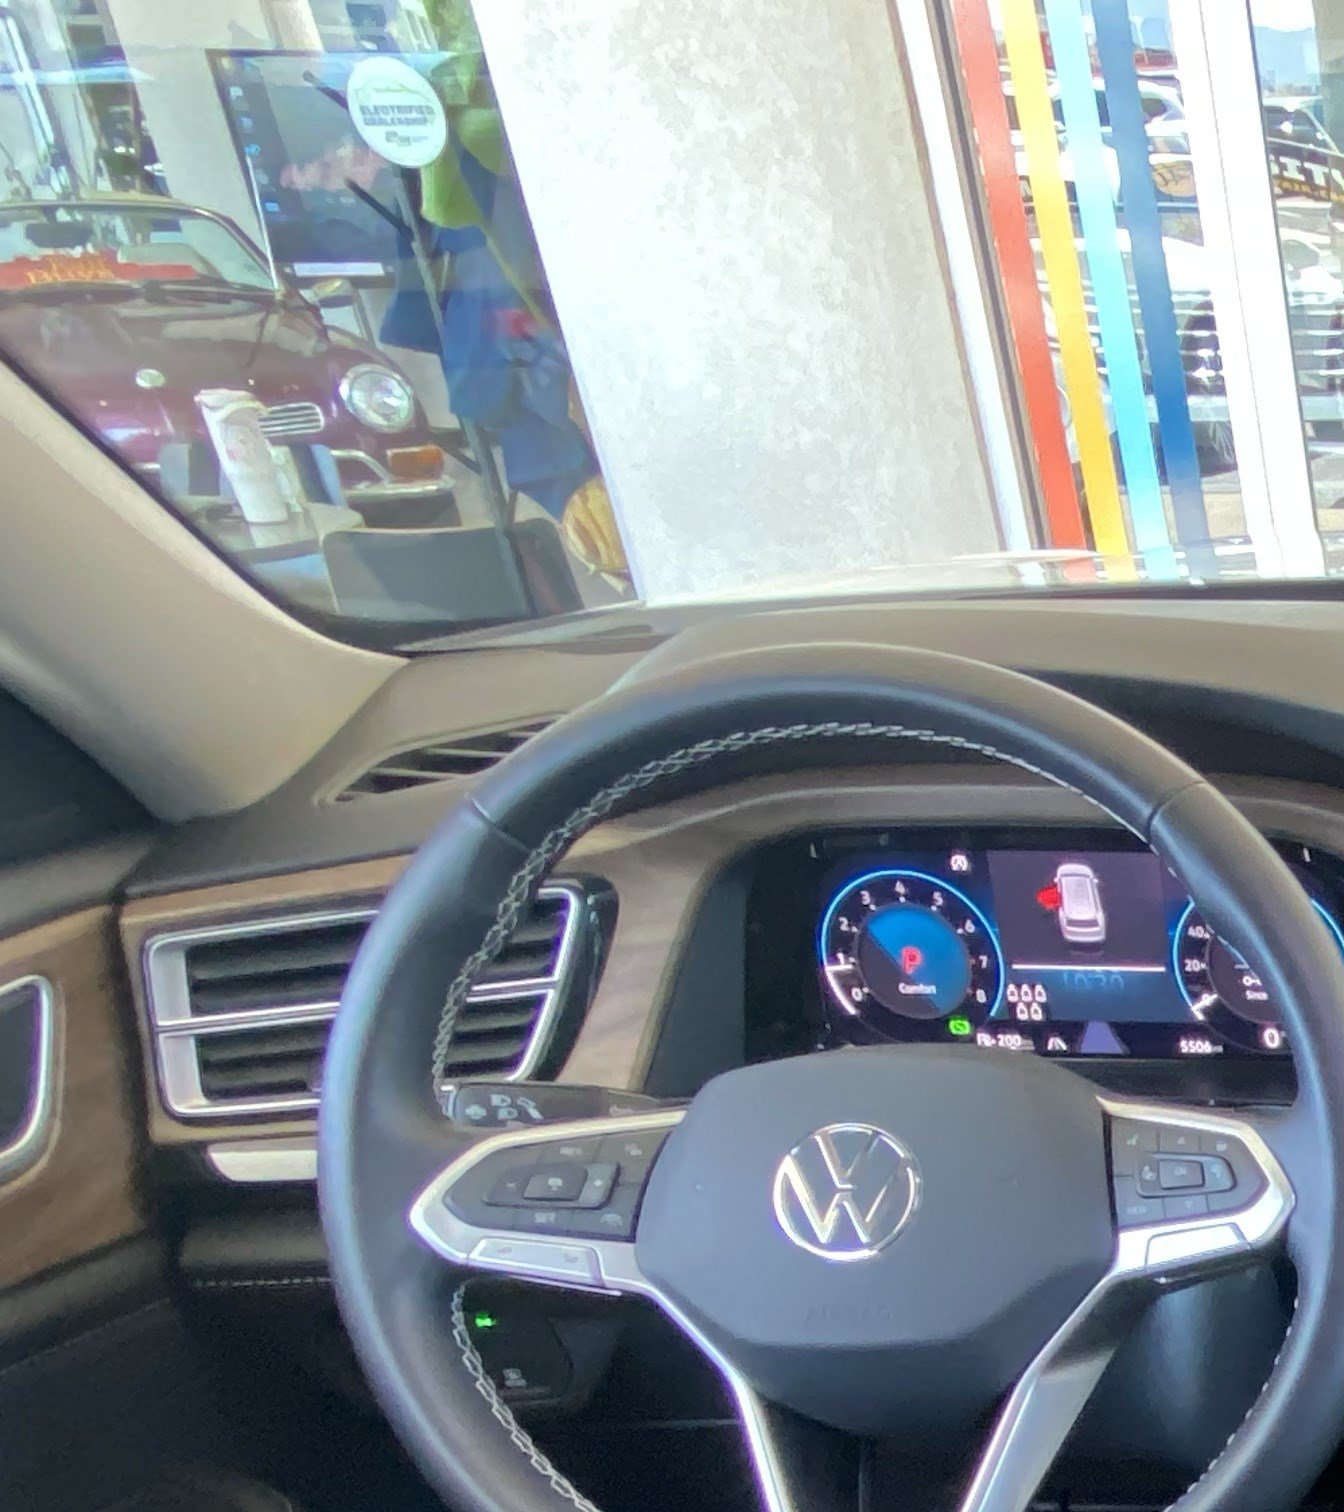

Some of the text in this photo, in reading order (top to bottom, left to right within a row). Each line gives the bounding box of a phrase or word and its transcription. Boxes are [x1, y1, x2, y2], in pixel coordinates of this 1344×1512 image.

[860, 889, 871, 906] 3
[838, 916, 850, 932] 2
[964, 918, 976, 934] 6
[901, 946, 922, 975] P
[1184, 958, 1201, 973] 20
[1263, 1027, 1280, 1049] 0
[1179, 1039, 1212, 1055] 5506
